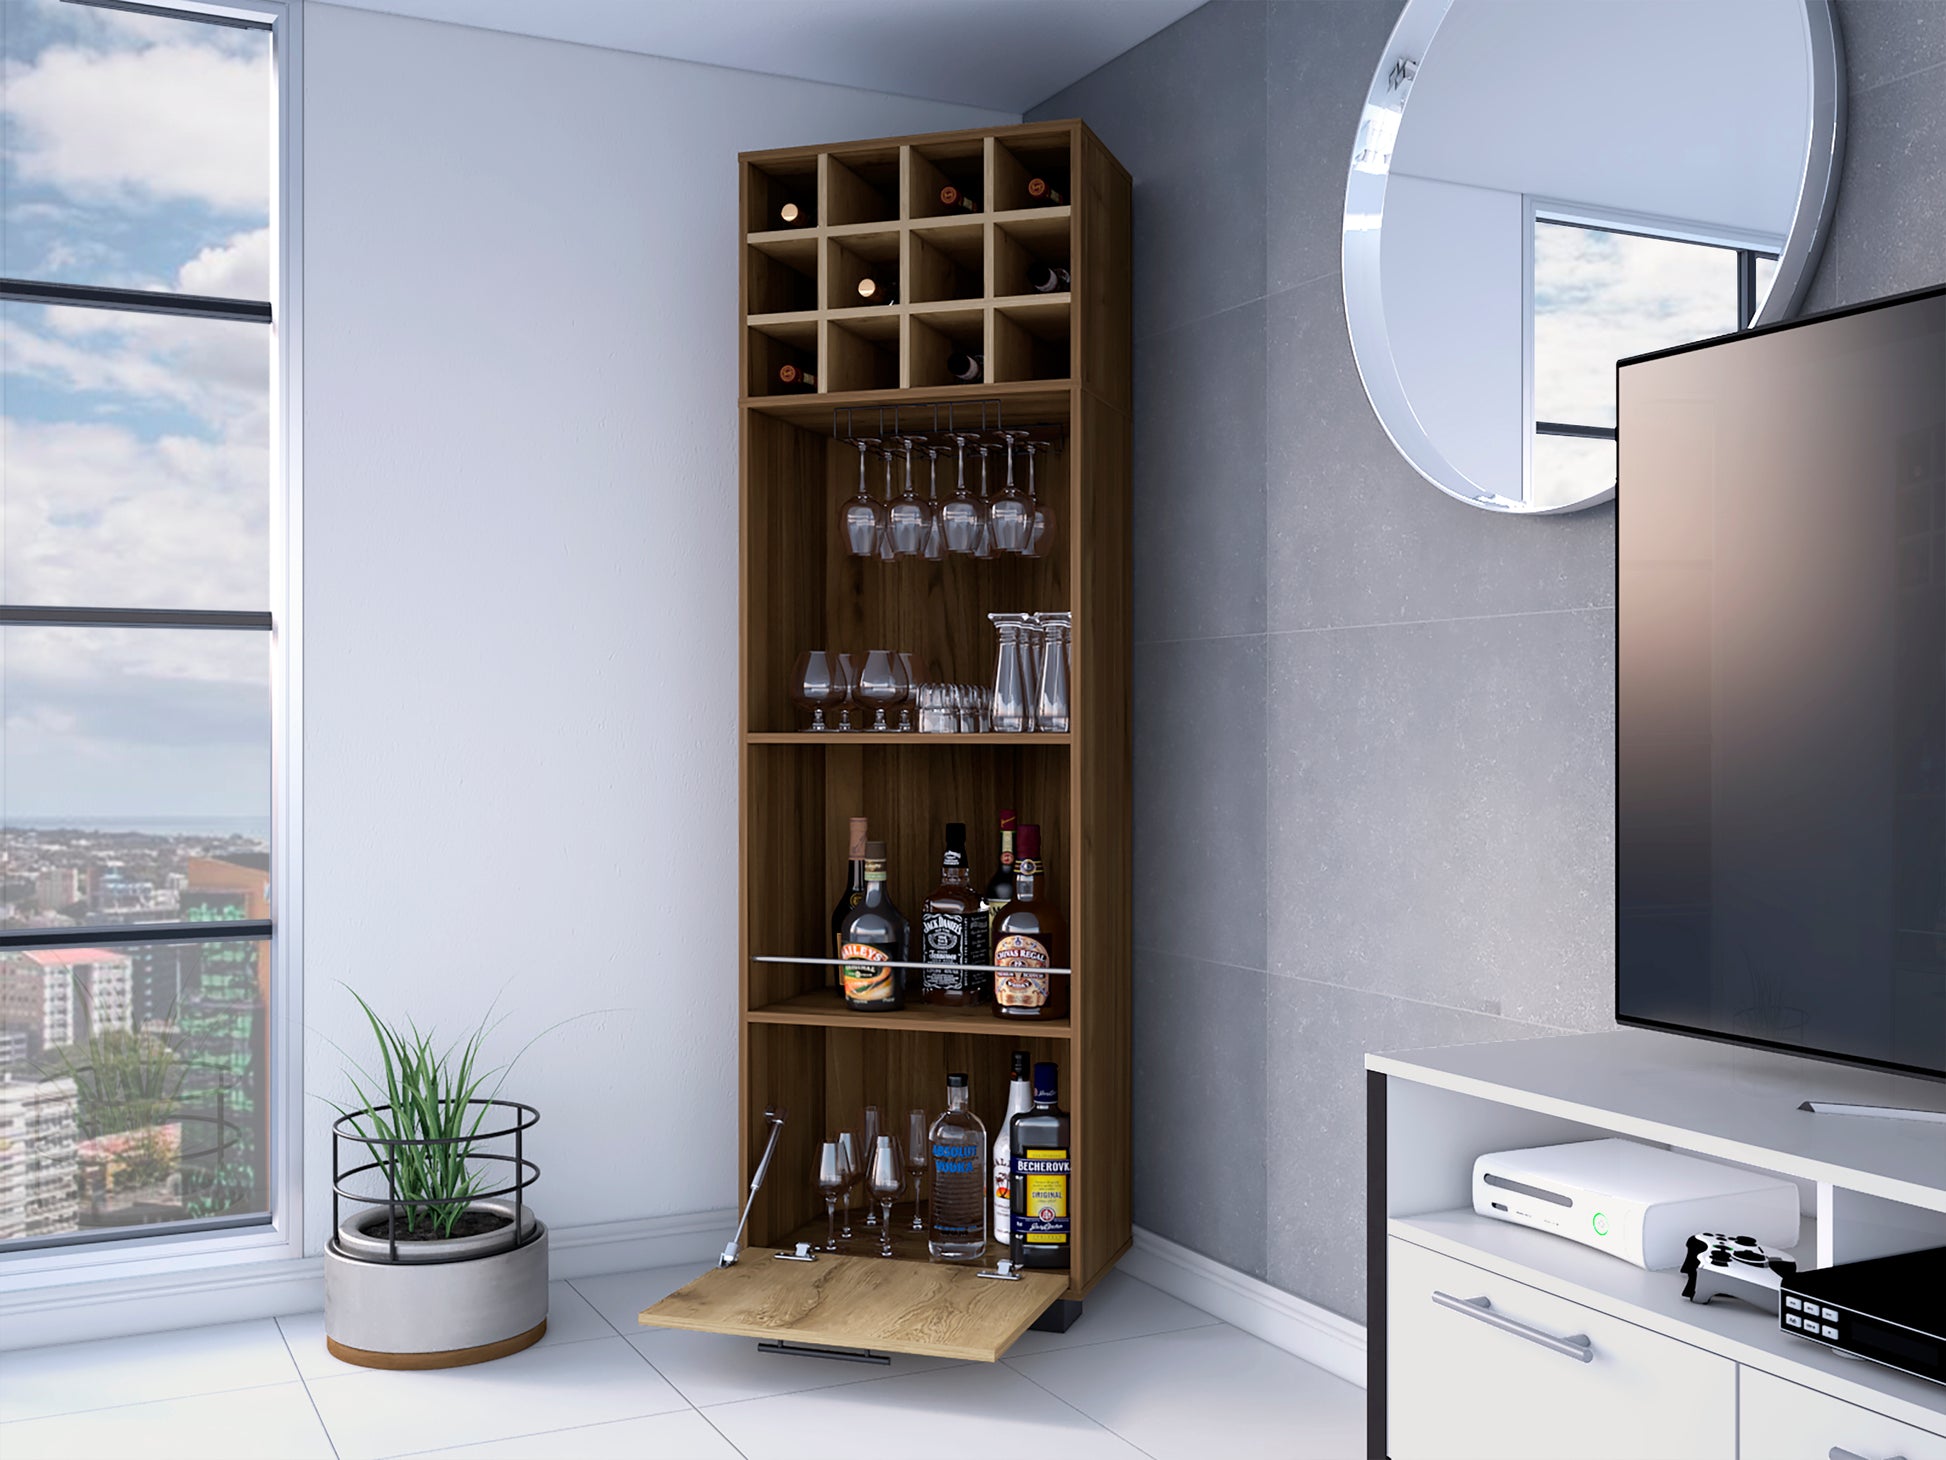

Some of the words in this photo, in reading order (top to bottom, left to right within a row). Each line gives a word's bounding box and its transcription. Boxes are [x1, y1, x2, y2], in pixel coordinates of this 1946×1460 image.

[923, 920, 938, 933] JACK
[1020, 949, 1044, 961] REGAL
[932, 1145, 977, 1157] ABSOLUT
[935, 1160, 974, 1172] VODKA
[1017, 1160, 1071, 1171] BECHEROVK
